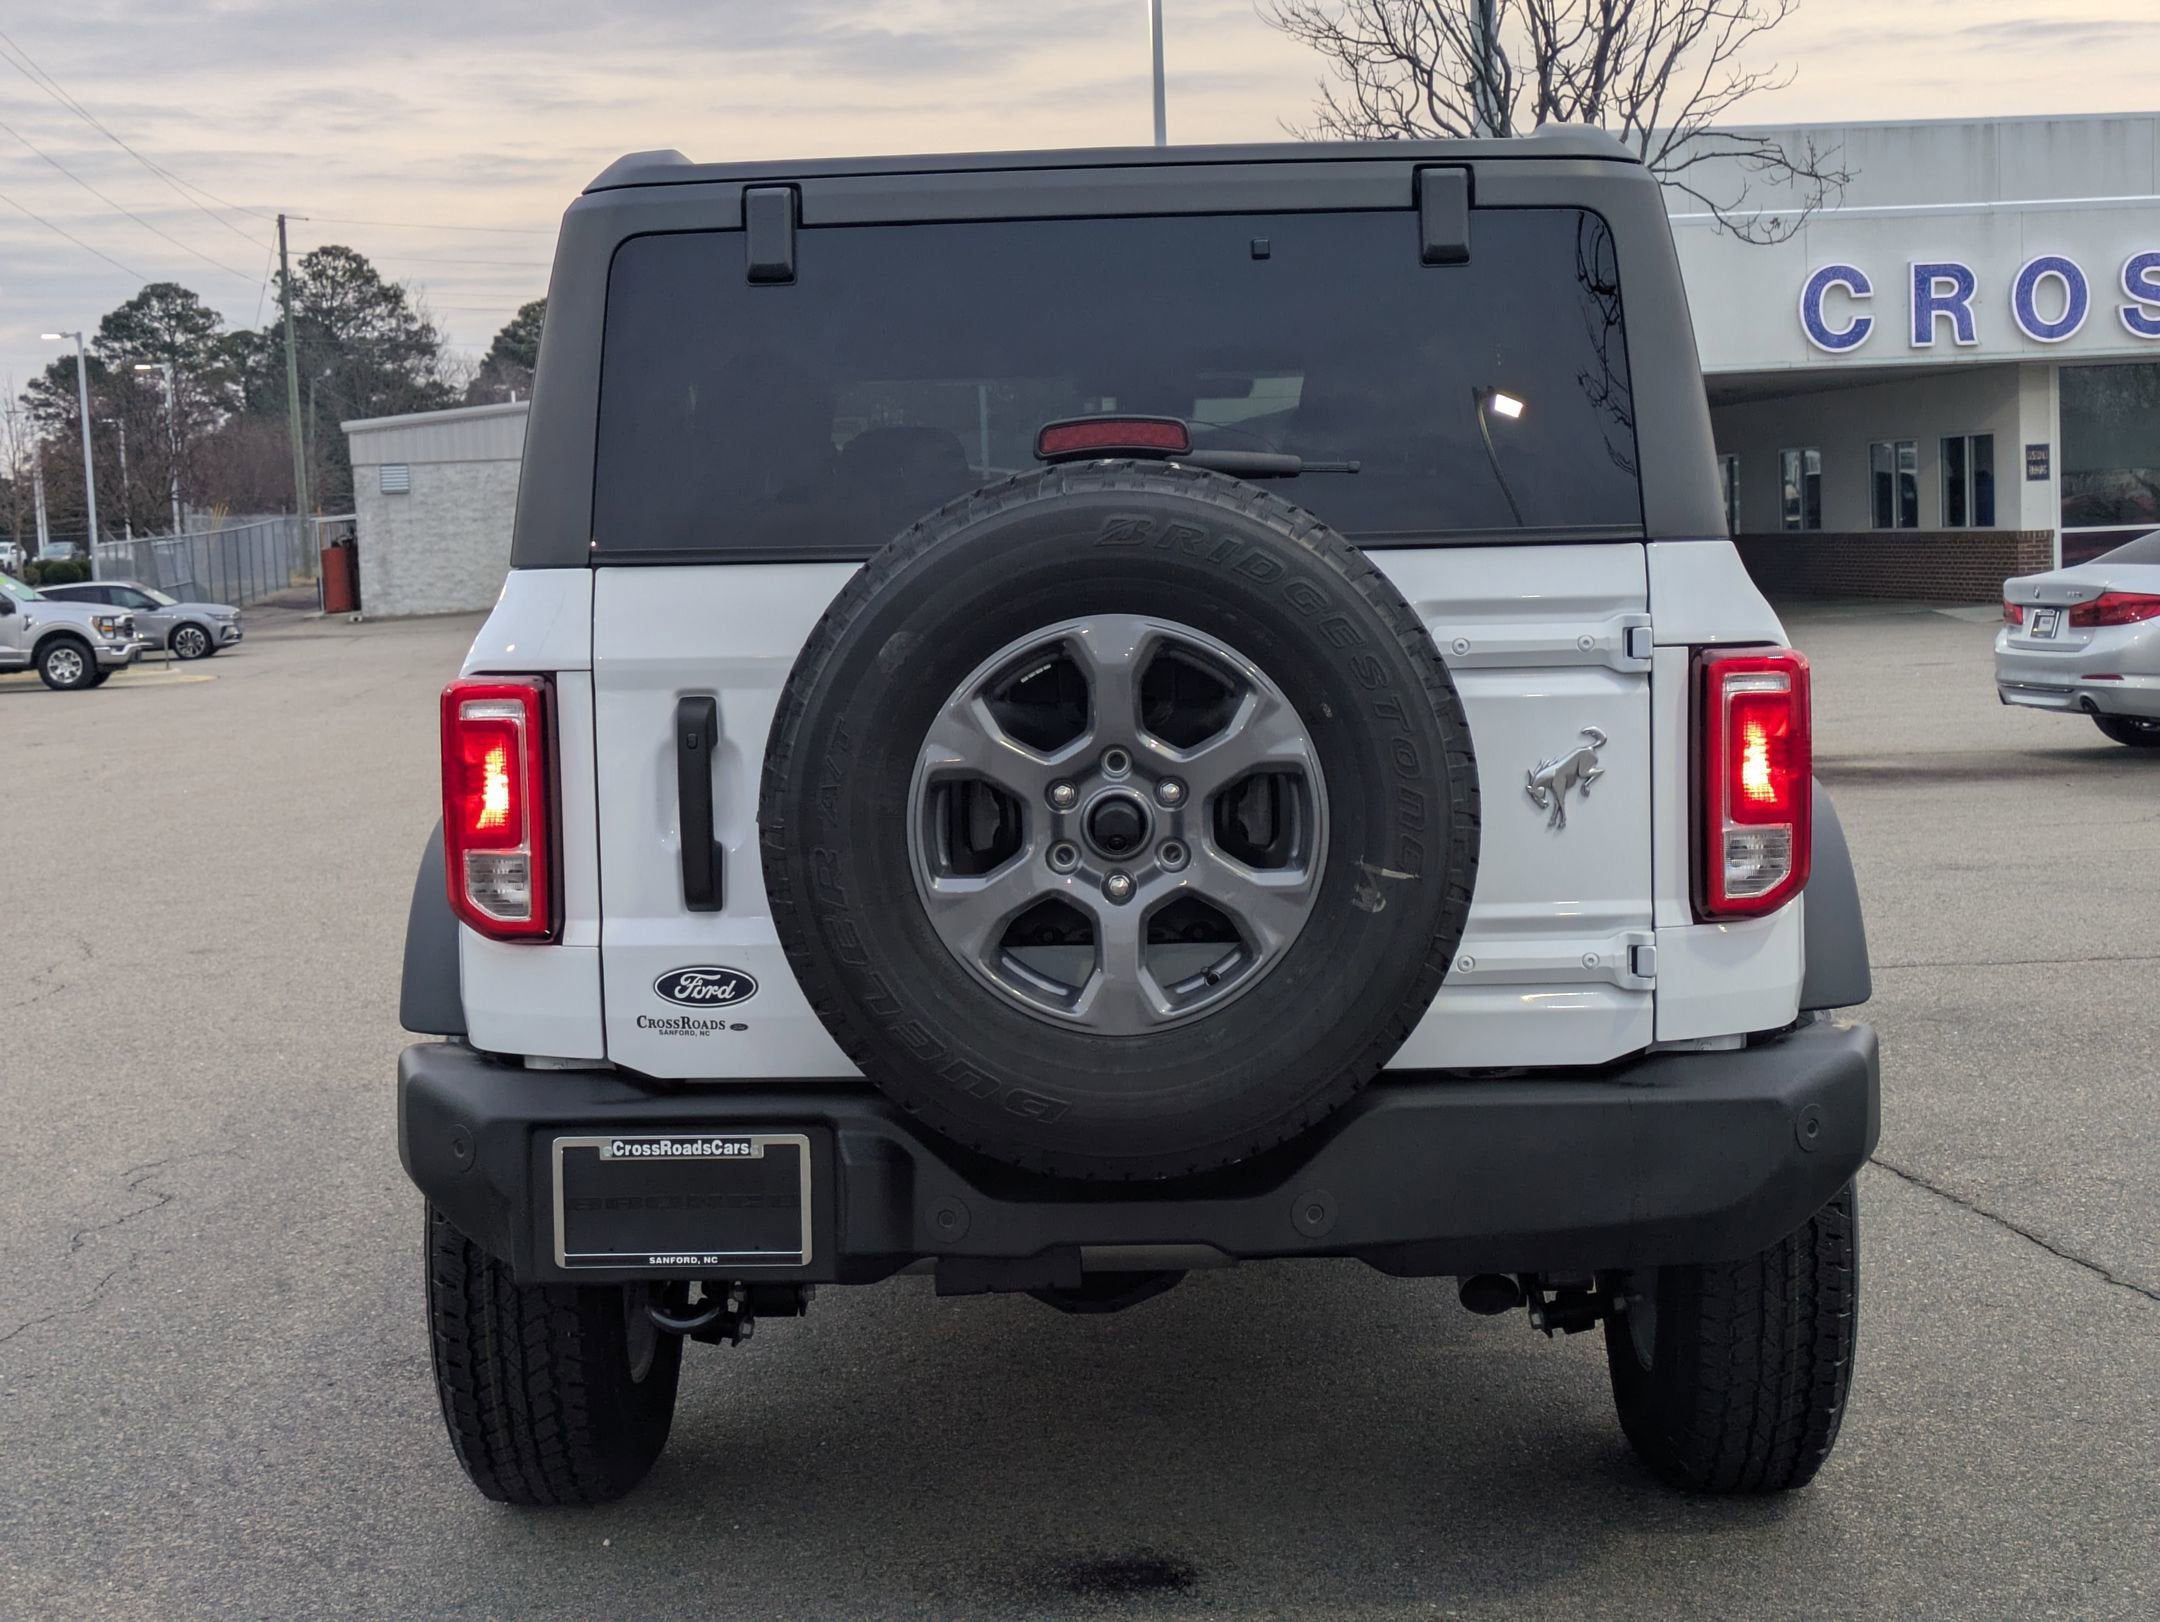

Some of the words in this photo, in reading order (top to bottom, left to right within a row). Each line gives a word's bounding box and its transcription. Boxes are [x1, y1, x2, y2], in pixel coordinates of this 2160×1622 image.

[1094, 514, 1427, 876] BRIDGESTONE
[674, 973, 736, 999] Ford
[806, 846, 1071, 1124] DUELER
[658, 1029, 698, 1037] SANFORD,
[613, 1140, 749, 1156] CrossRoadsCars
[649, 1256, 701, 1265] SANFORD,
[703, 1256, 718, 1264] NC
